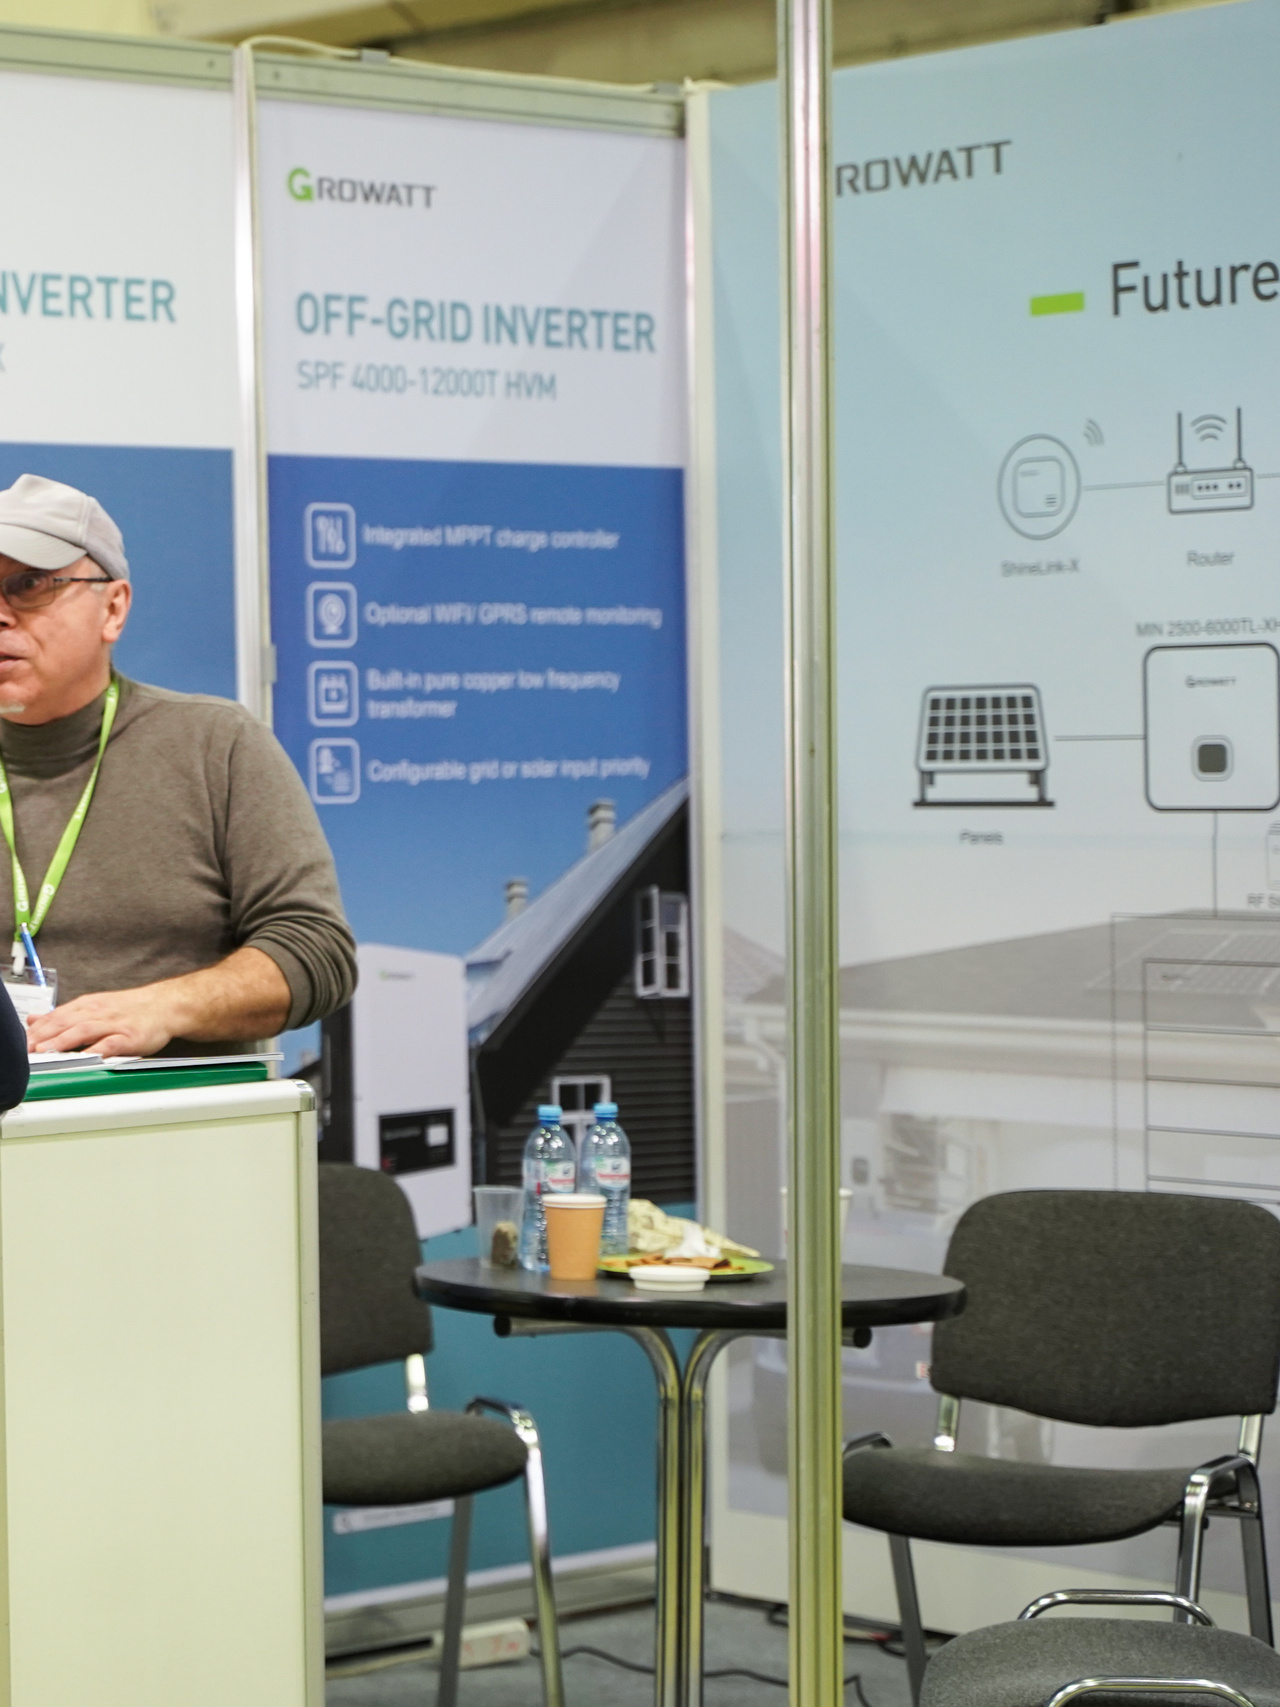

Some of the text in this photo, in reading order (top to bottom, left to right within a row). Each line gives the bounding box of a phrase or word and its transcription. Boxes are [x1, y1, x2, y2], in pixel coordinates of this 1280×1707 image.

[835, 140, 1012, 197] ROWATT
[287, 167, 437, 209] GROWATT
[1111, 259, 1280, 316] Future
[296, 291, 657, 353] OFF-GRID INVERTER
[296, 359, 558, 401] SPF 4000-12000T HVM
[362, 524, 621, 552] Integrated MPPT charge controller
[1186, 549, 1236, 567] Router
[364, 601, 432, 628] Optional
[530, 606, 583, 625] remote
[585, 606, 663, 630] monitoring
[462, 671, 517, 694] copper
[546, 668, 620, 694] frequency
[367, 696, 458, 719] transformer
[367, 759, 467, 786] Configurable
[469, 758, 500, 784] grid
[520, 759, 558, 779] solar
[601, 756, 651, 780] priority
